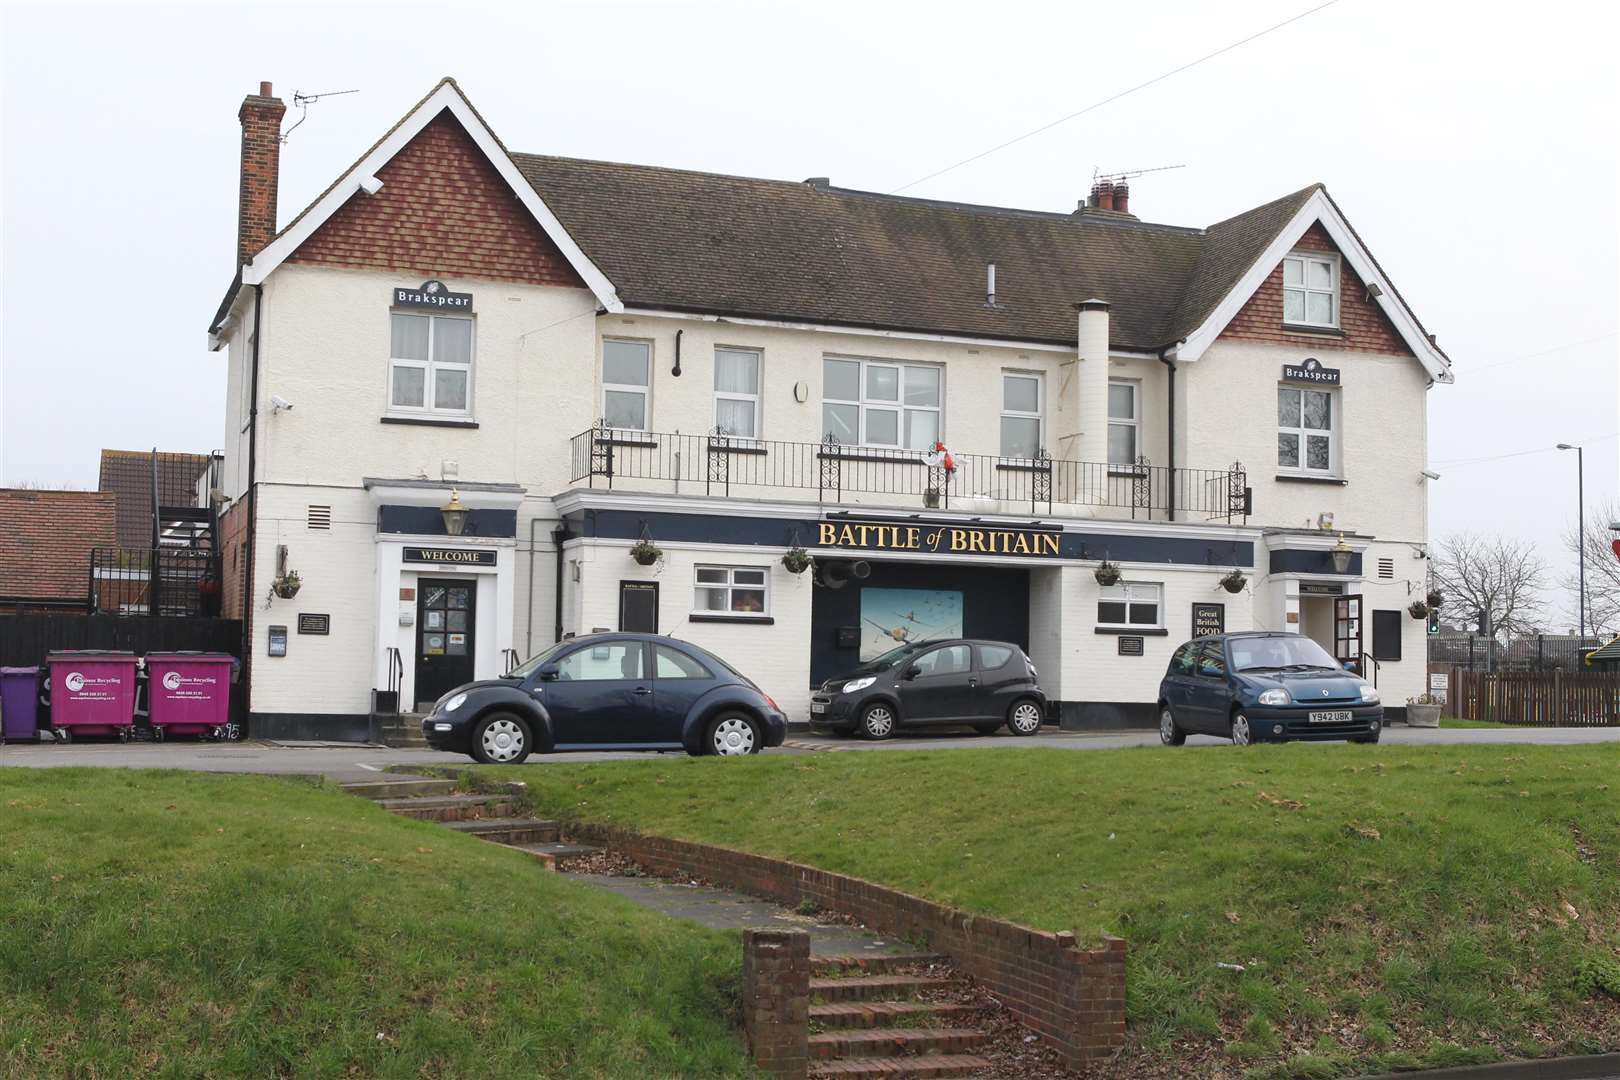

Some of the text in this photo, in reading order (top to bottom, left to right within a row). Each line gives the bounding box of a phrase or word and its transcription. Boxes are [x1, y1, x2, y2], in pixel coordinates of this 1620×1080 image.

[398, 291, 469, 306] Brakspear
[1286, 368, 1338, 381] Brakspear
[818, 523, 1061, 555] BATTLE of BRITAIN
[421, 550, 480, 562] WELCOME
[1196, 618, 1219, 626] British
[1196, 627, 1220, 636] FOOD
[1312, 712, 1350, 721] Y942 UBK
